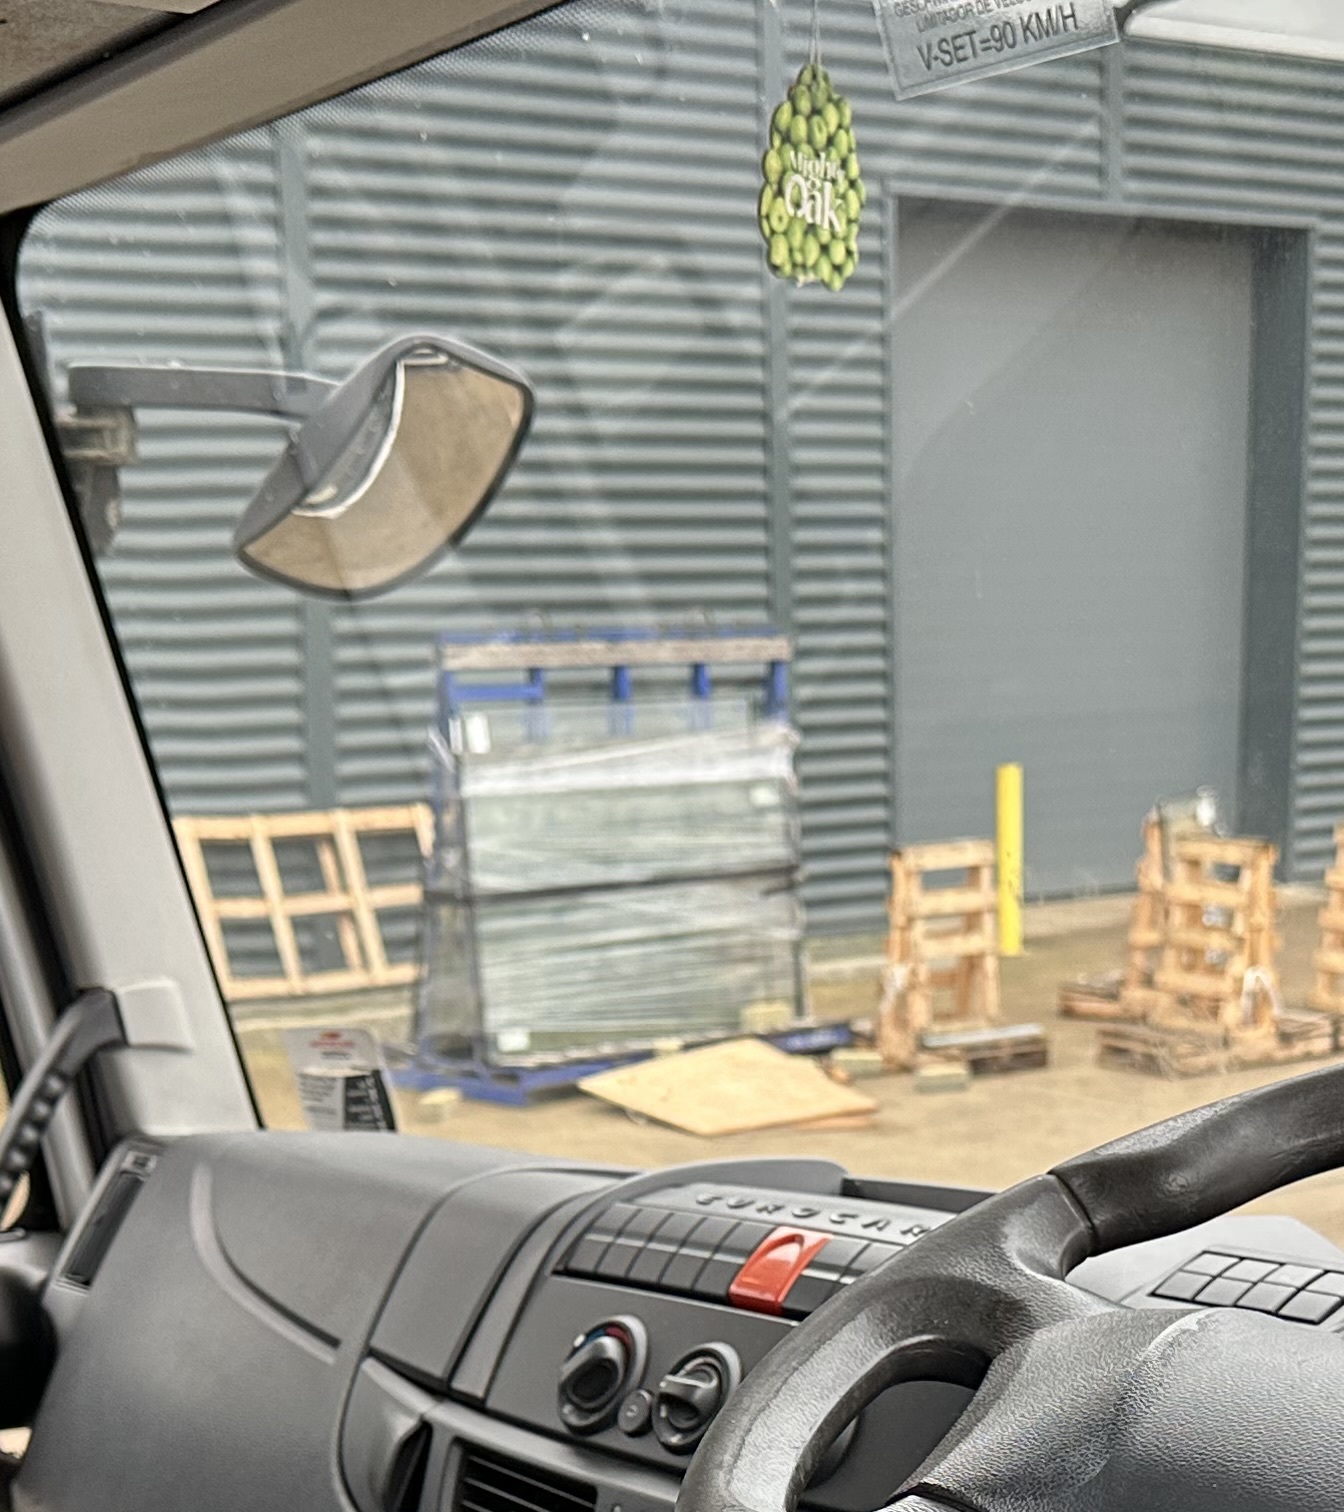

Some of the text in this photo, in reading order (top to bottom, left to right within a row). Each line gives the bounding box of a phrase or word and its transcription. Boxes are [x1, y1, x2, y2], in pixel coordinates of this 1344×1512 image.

[917, 2, 1079, 72] V-SET=90 KM/H
[784, 173, 843, 233] Oak
